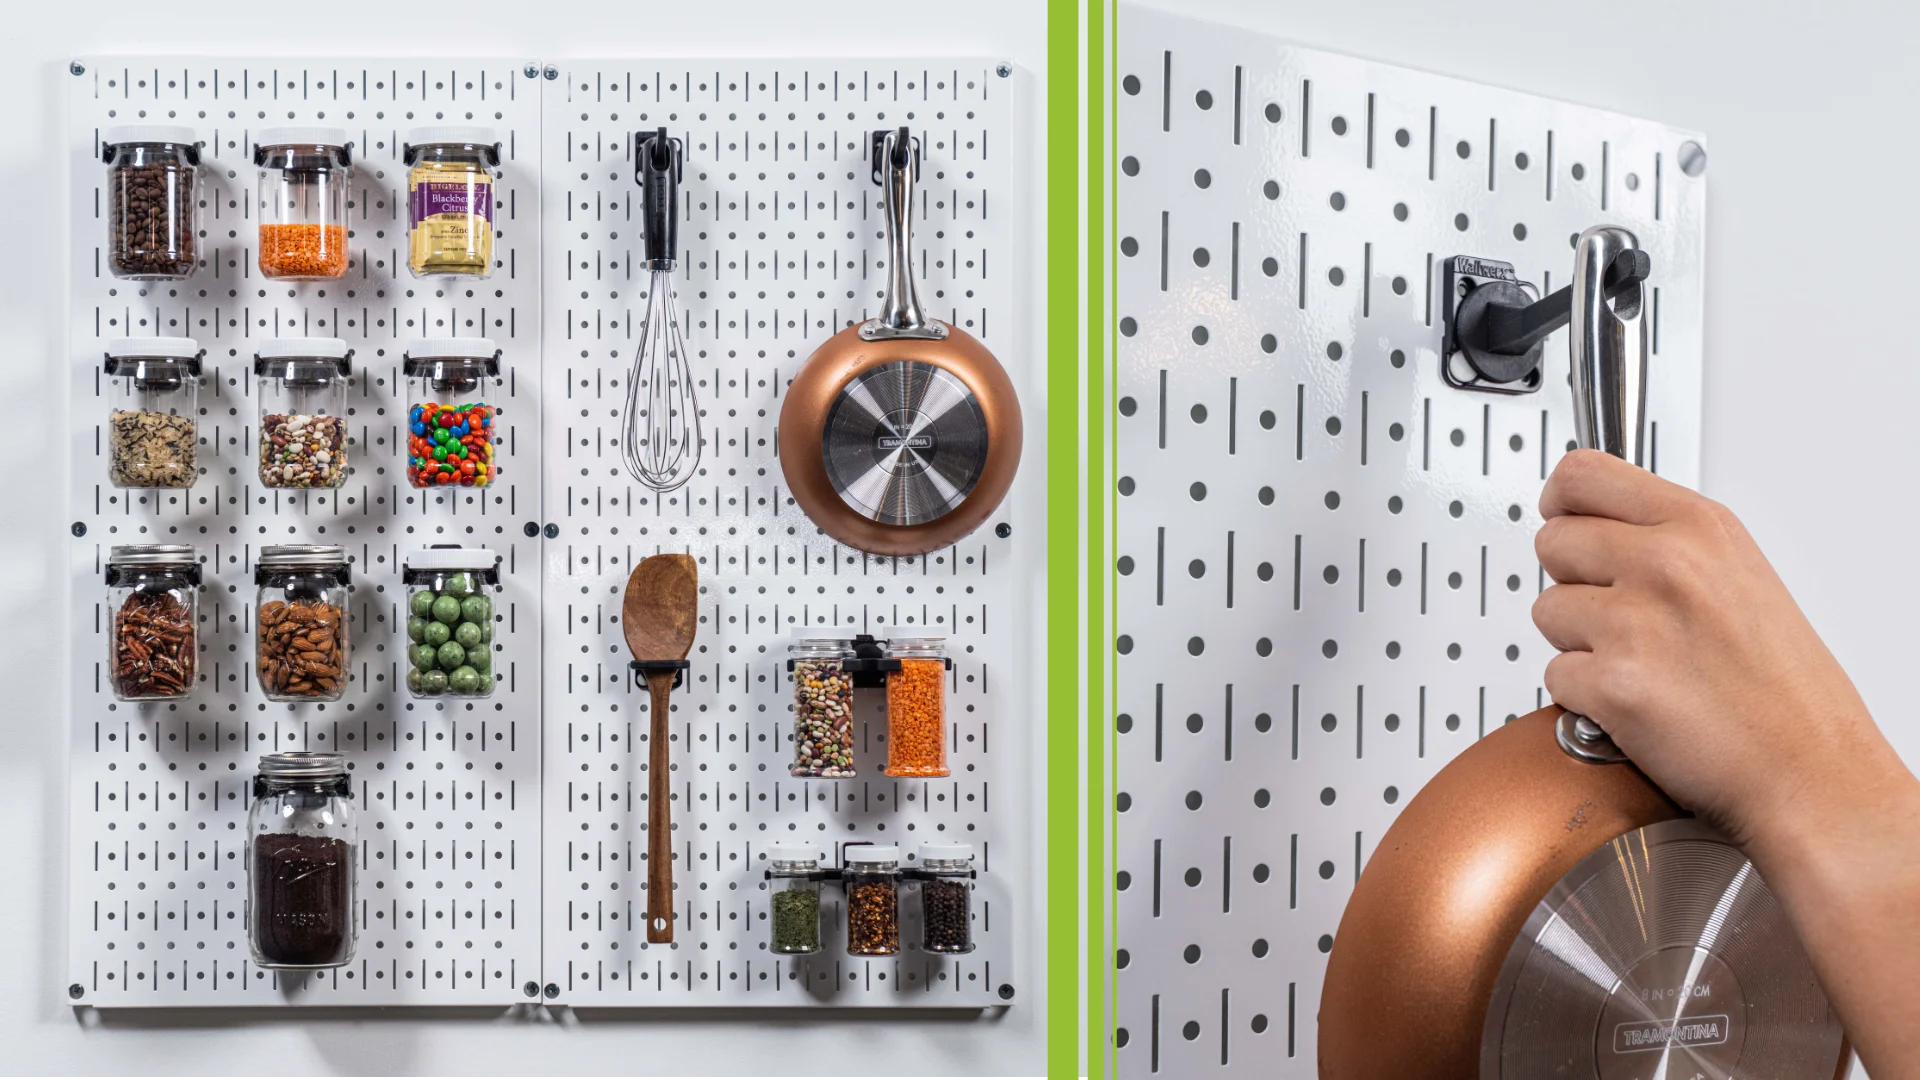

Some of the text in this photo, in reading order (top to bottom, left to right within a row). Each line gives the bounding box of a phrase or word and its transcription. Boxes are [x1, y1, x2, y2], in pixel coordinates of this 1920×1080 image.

[432, 194, 478, 205] Blackbery
[442, 203, 469, 212] Citrus
[450, 226, 468, 234] Zinc
[882, 438, 928, 447] TRAMNTINA
[1651, 989, 1664, 1001] IN
[1693, 984, 1710, 997] CM
[1623, 1023, 1719, 1046] TRAMONTINA
